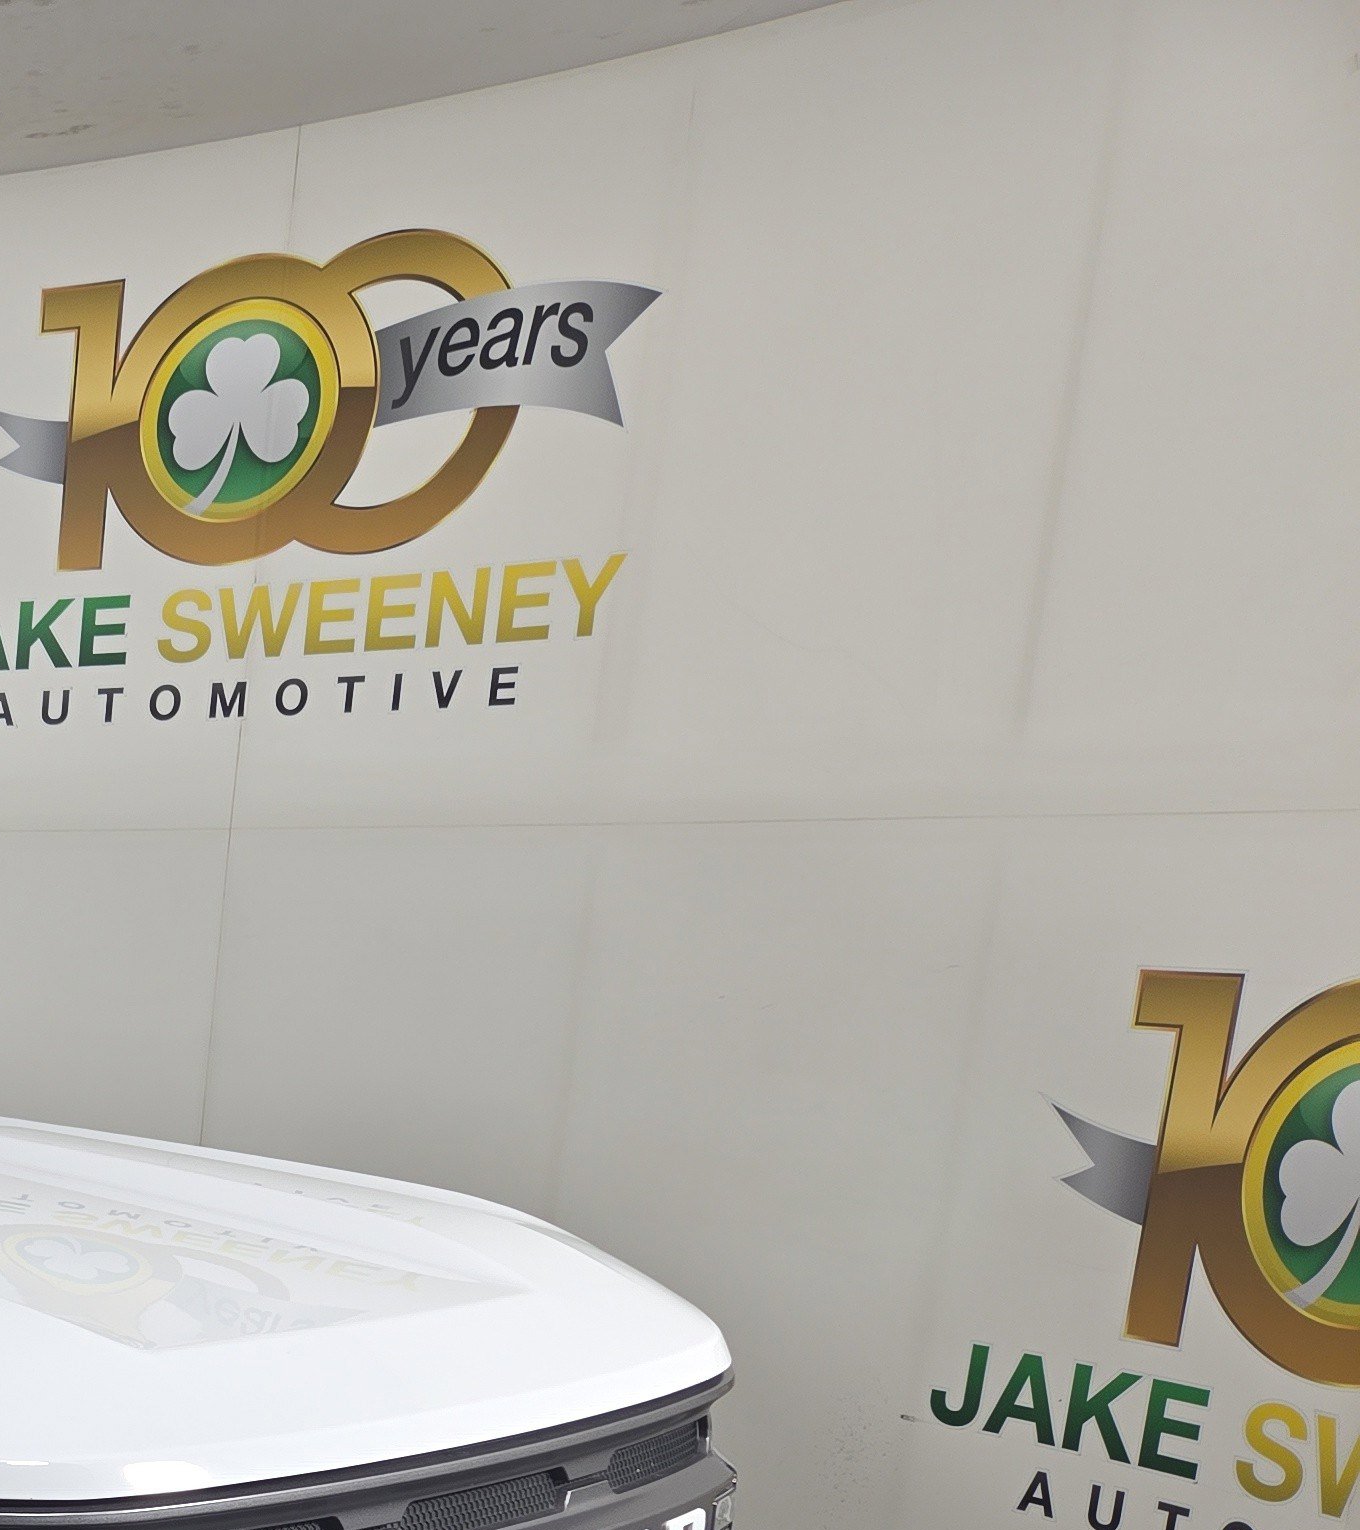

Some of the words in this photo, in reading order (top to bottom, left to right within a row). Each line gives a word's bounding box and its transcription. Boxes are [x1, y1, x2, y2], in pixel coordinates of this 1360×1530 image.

[39, 228, 523, 572] 100
[392, 300, 594, 406] years
[157, 551, 628, 664] SWEENEY
[930, 1343, 1211, 1481] JAKE
